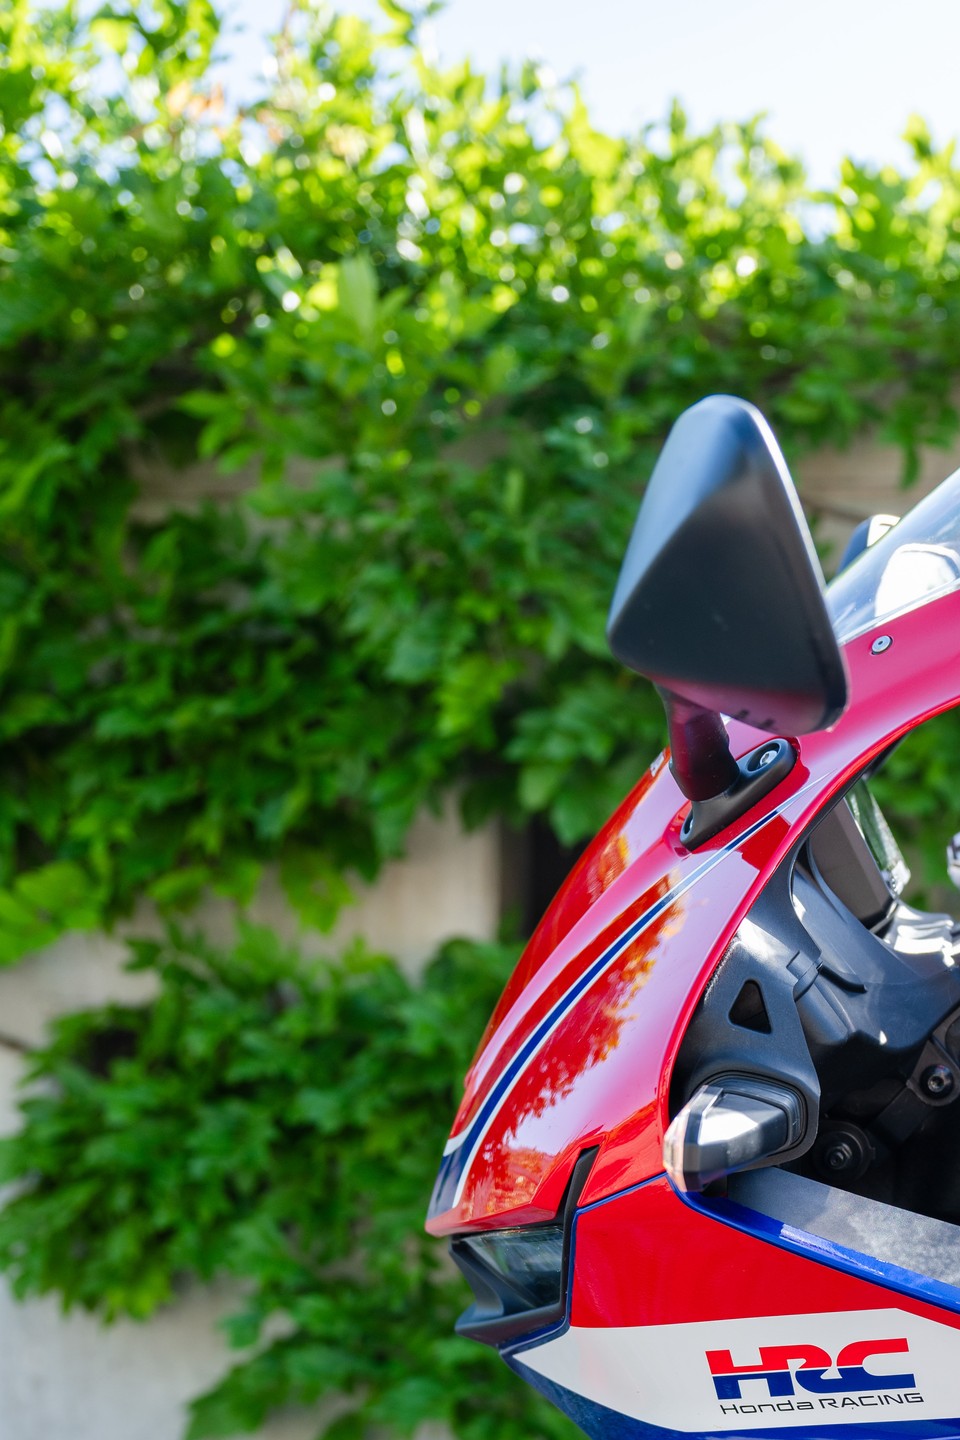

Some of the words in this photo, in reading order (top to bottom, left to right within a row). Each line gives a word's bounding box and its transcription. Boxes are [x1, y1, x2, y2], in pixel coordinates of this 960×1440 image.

[705, 1338, 917, 1400] HRC
[720, 1399, 814, 1415] Honda
[818, 1392, 925, 1409] RACING
